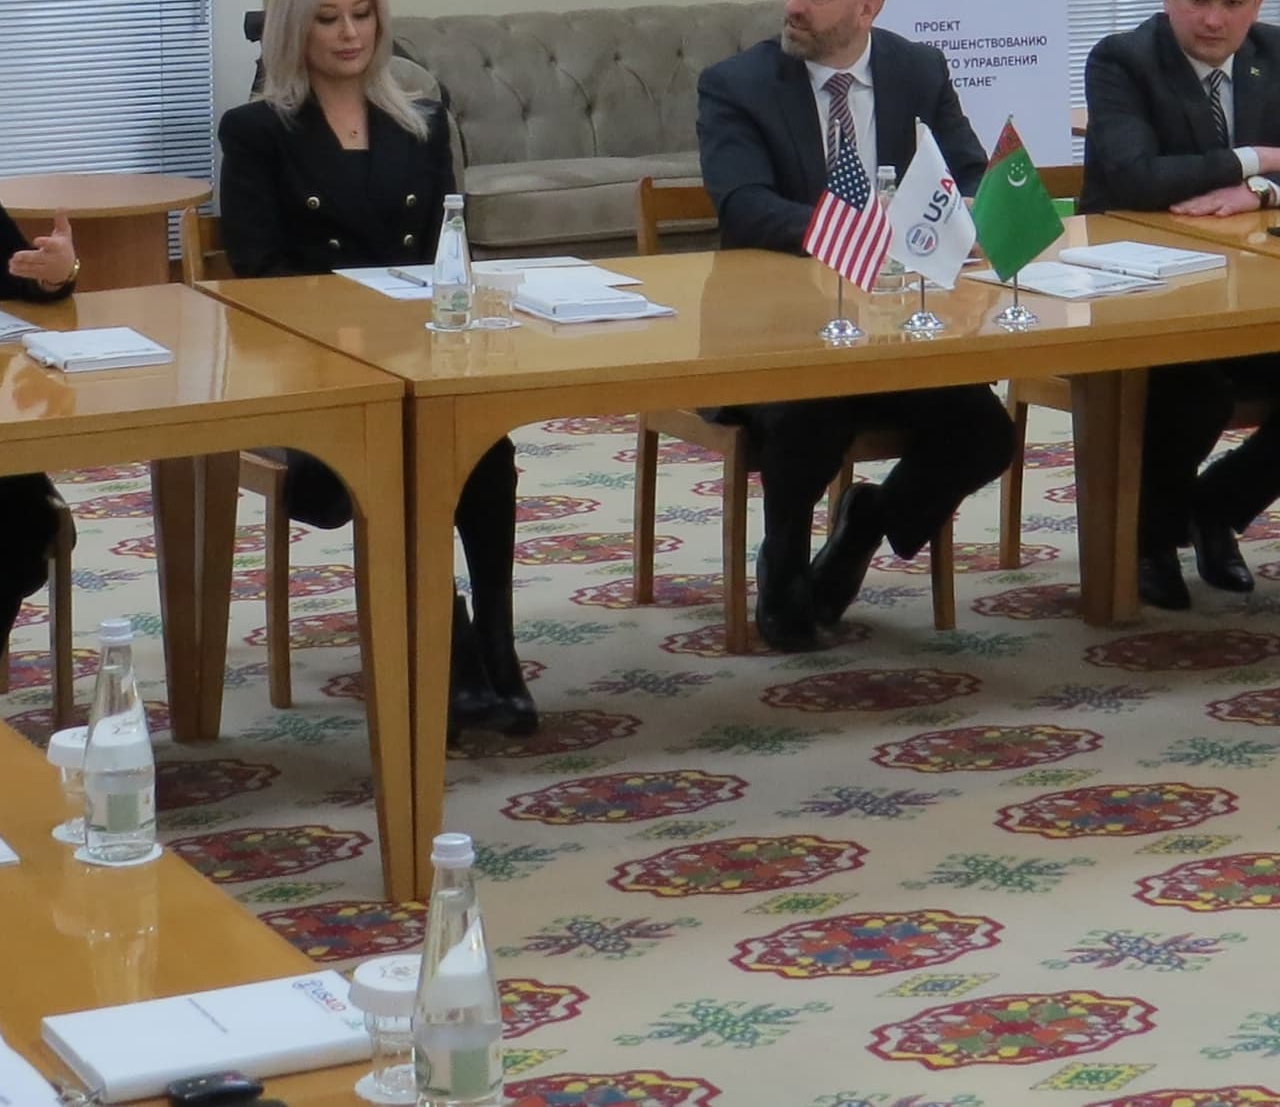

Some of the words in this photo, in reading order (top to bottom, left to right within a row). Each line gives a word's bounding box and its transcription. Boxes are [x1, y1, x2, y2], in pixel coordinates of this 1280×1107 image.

[914, 20, 961, 33] ПРОЕКТ
[963, 54, 1038, 69] УПРАВЛЕНИЯ
[923, 168, 954, 222] USA
